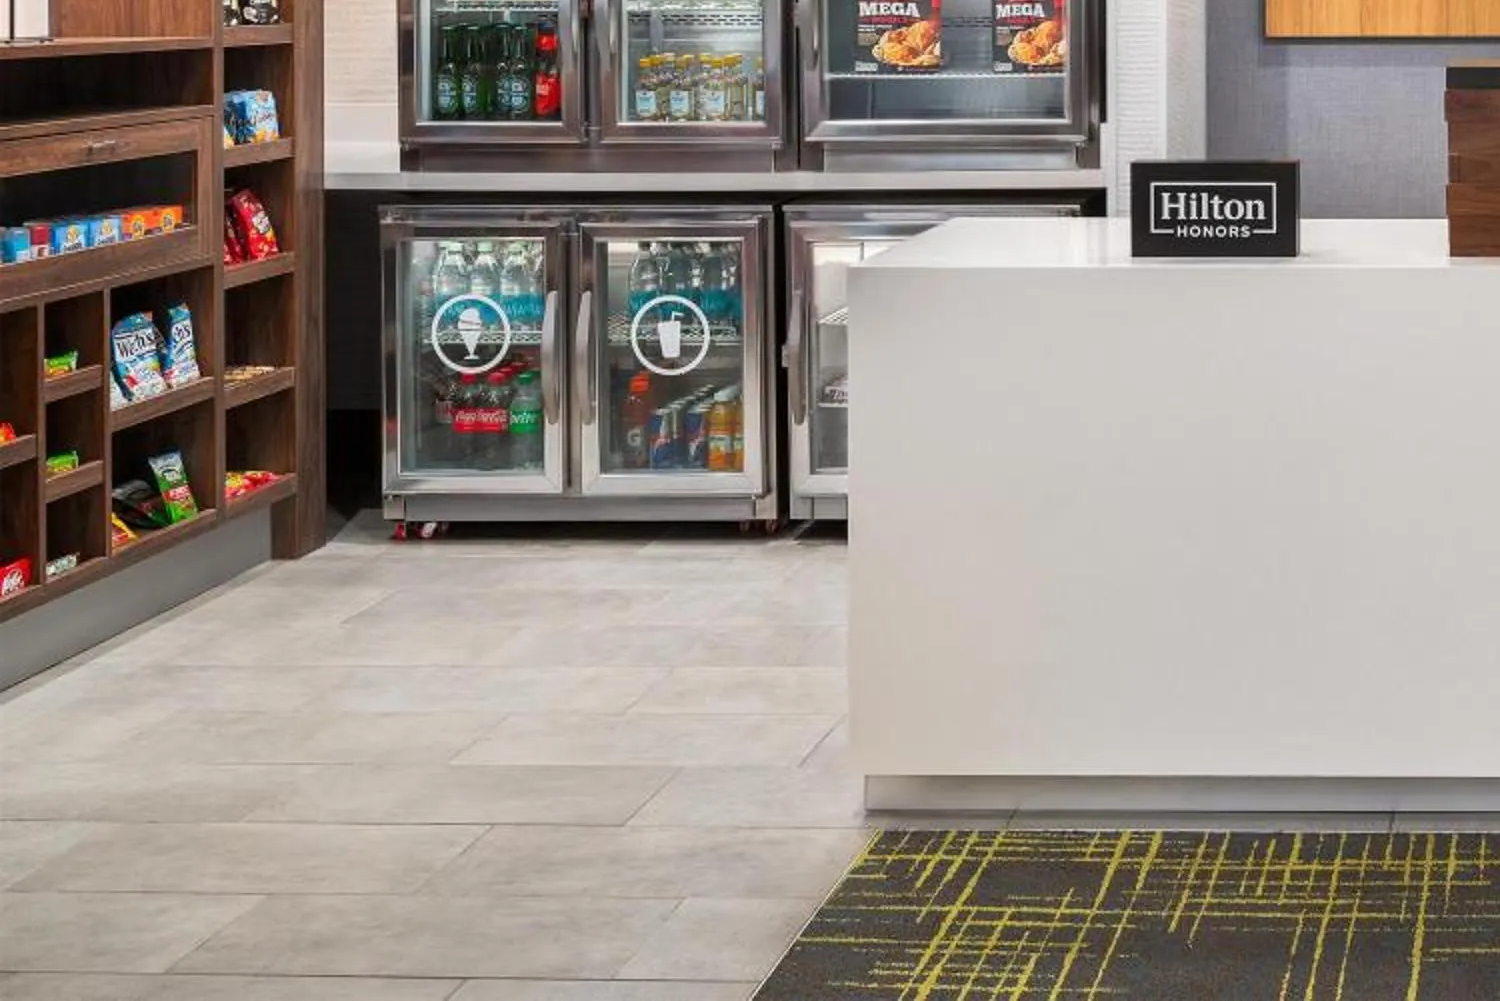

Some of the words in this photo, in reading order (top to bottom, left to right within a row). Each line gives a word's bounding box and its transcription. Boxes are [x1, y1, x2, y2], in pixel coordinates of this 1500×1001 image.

[859, 1, 921, 18] MEGA
[995, 2, 1046, 20] MEGA
[1161, 192, 1267, 220] Hilton
[1177, 225, 1251, 238] HONORS
